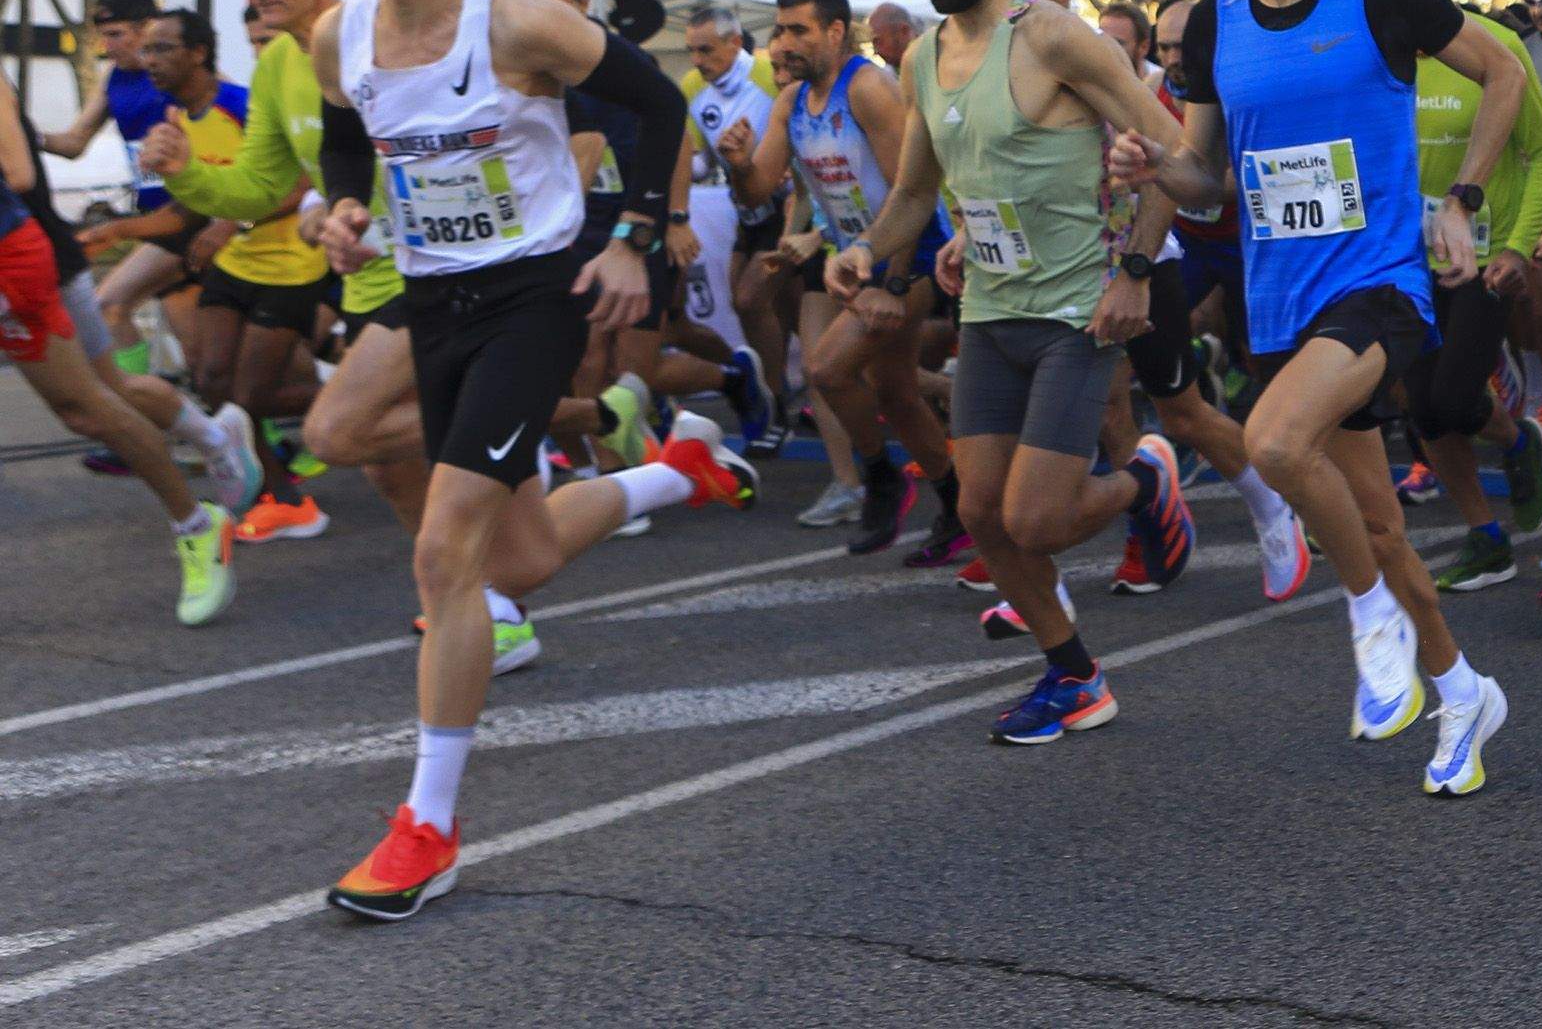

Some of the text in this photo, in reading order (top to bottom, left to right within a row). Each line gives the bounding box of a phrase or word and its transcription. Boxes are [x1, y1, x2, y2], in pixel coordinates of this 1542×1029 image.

[1280, 157, 1328, 171] MetLife
[421, 212, 495, 244] 3826
[1282, 199, 1324, 230] 470
